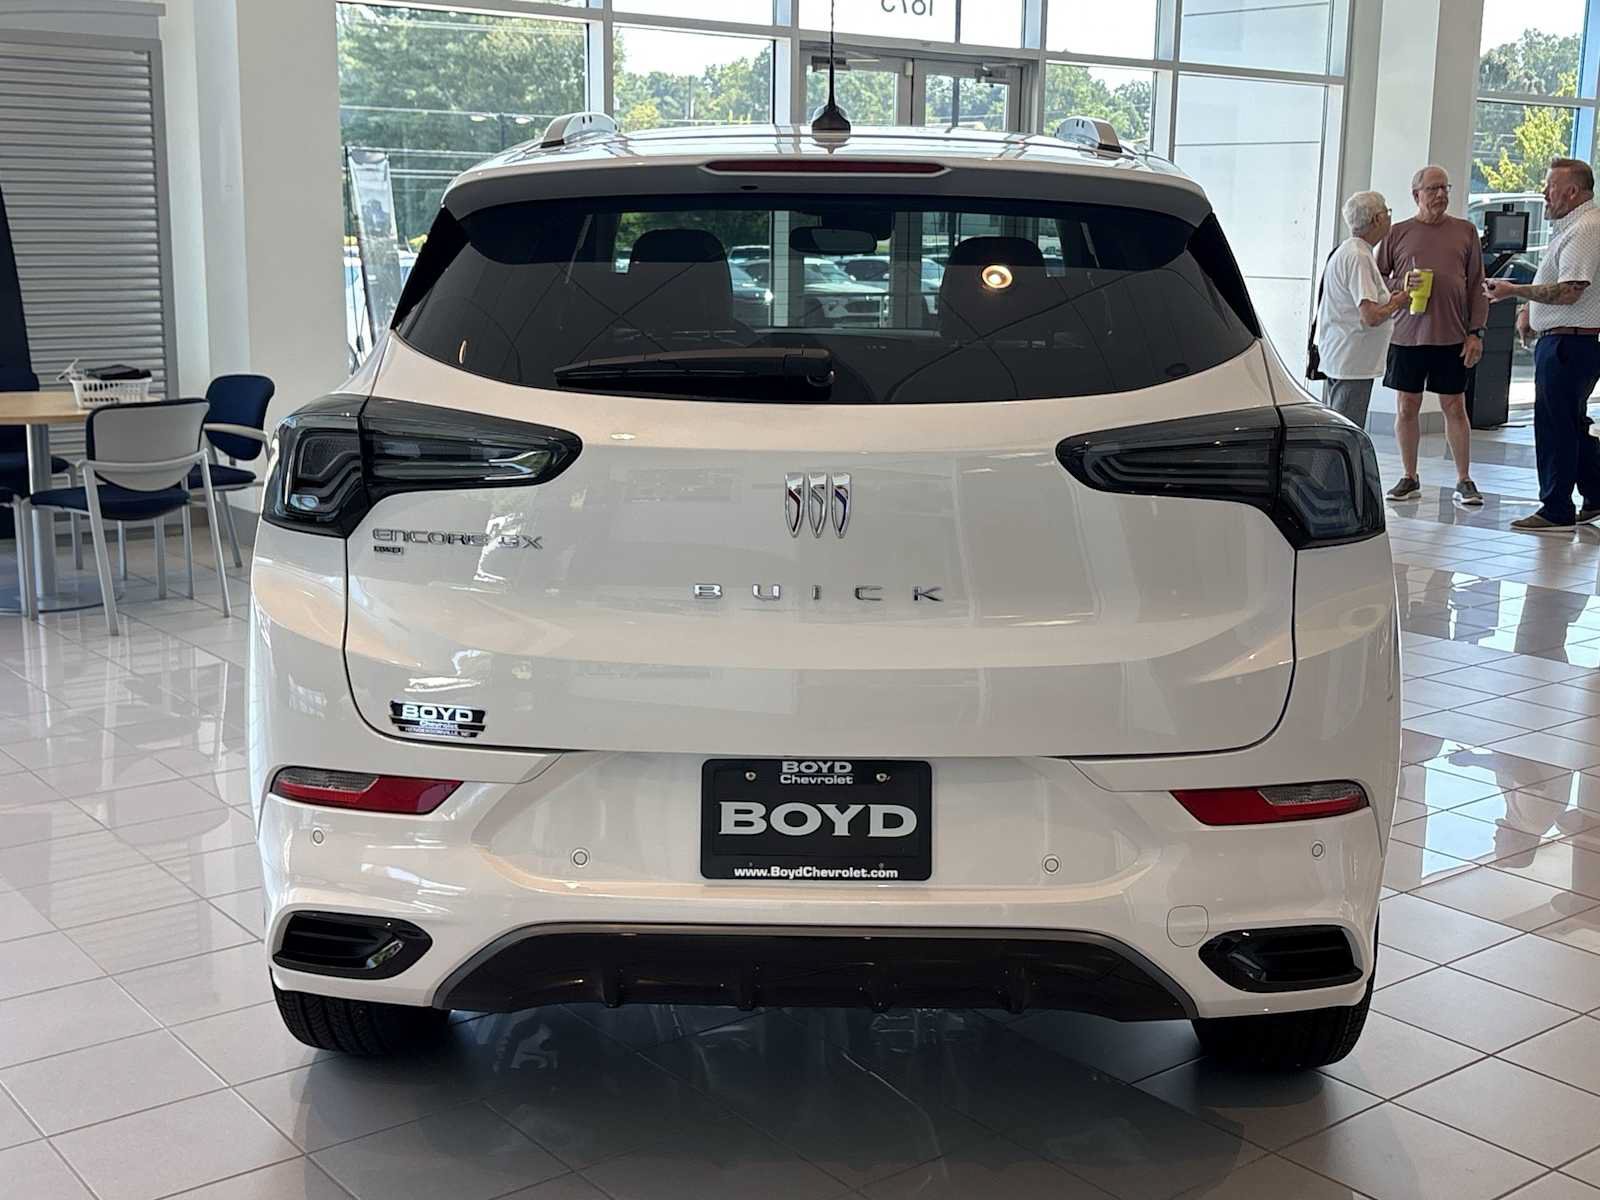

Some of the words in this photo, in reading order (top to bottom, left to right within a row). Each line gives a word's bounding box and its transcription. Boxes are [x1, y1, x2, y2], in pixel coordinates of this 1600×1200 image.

[372, 528, 489, 546] ENCORE
[498, 534, 543, 549] GX
[694, 583, 945, 601] BUICK
[402, 704, 473, 721] BOYD
[781, 760, 852, 774] BOYD
[780, 773, 854, 785] Chevrolet
[718, 800, 918, 838] BOYD
[734, 865, 898, 880] www.BoydChevrolet.com
